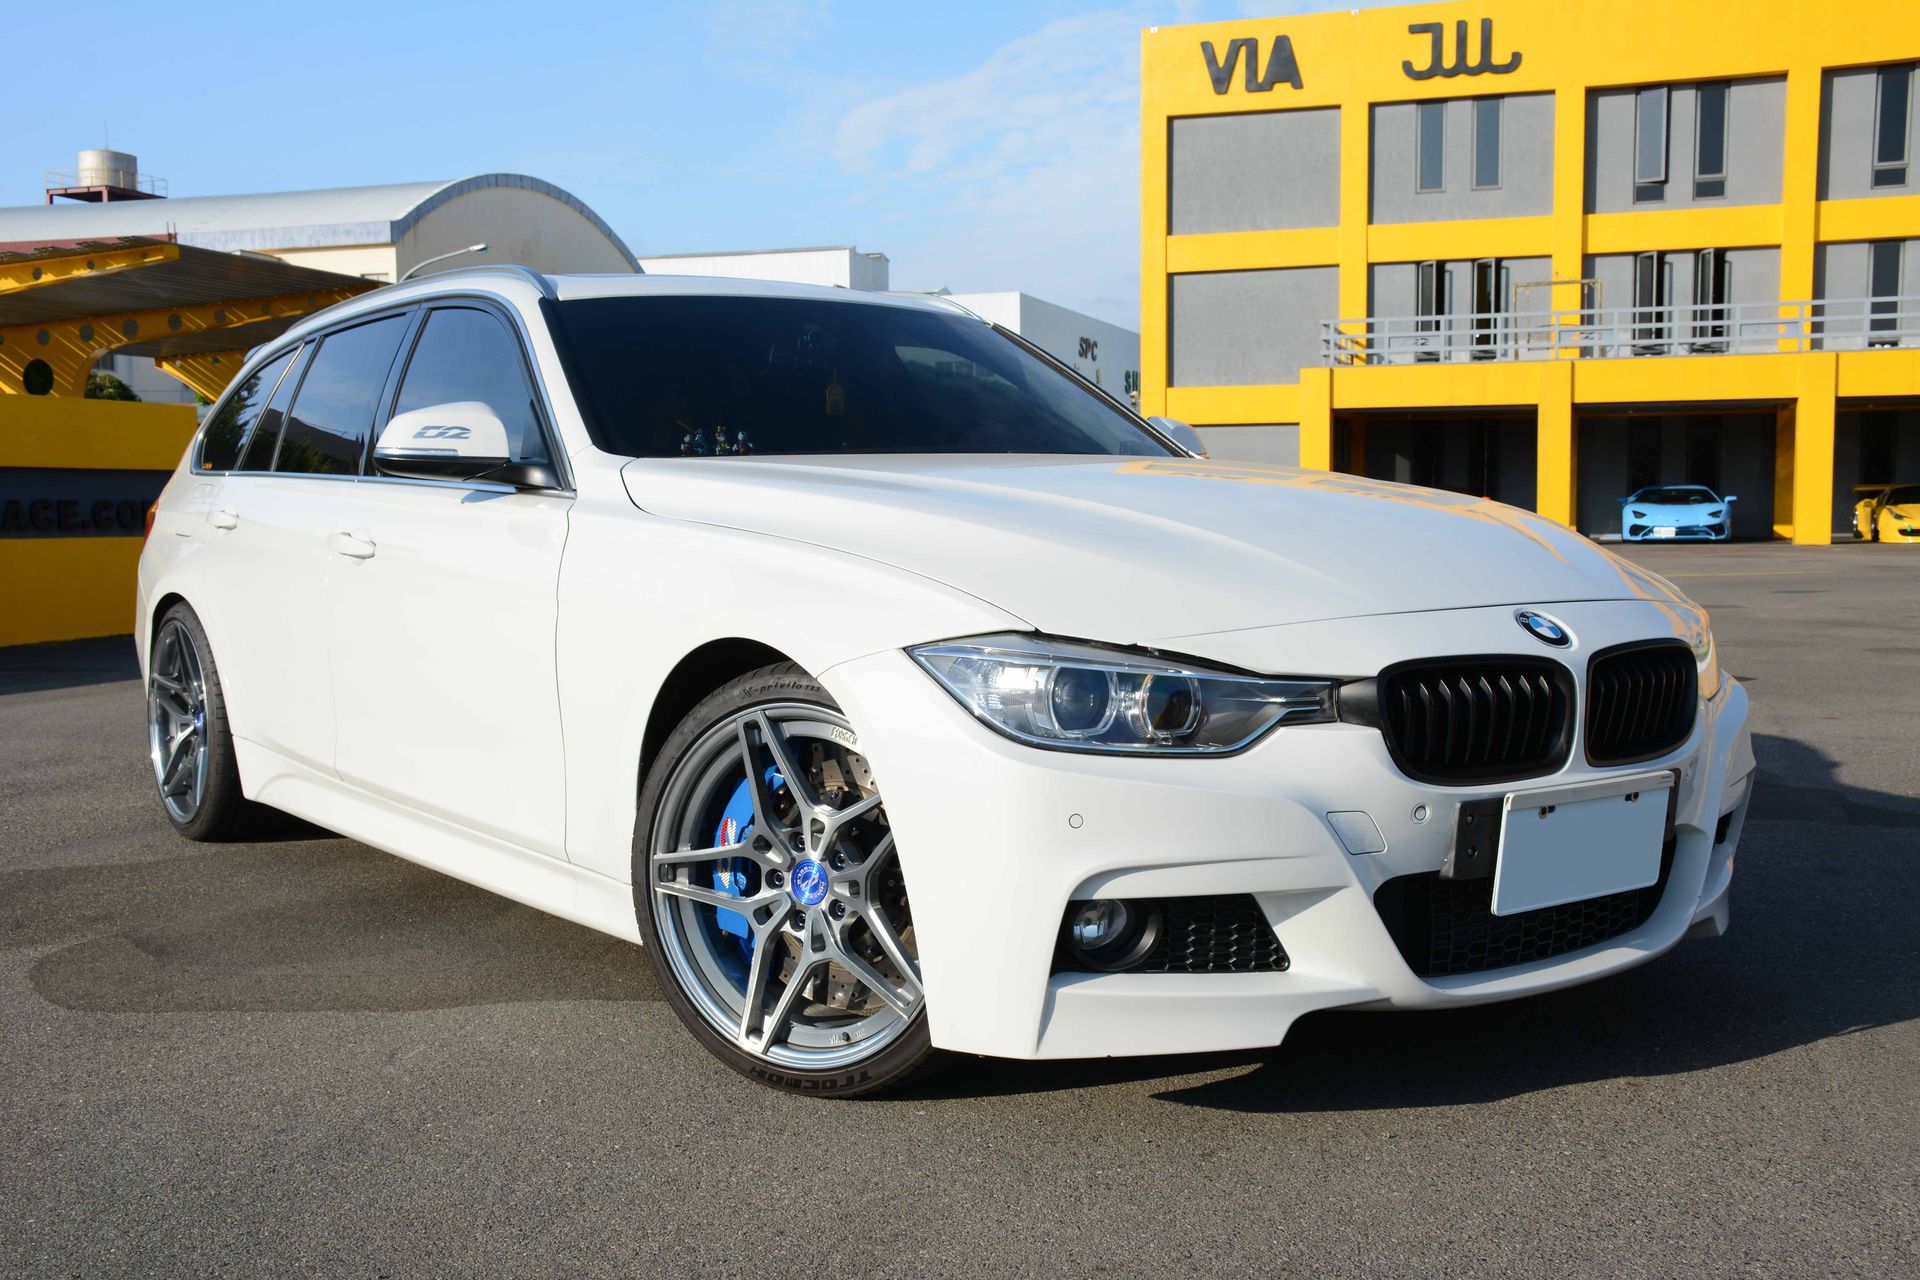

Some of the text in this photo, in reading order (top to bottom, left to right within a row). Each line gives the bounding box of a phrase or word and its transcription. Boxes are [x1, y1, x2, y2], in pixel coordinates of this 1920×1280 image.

[1200, 35, 1304, 95] VIA
[1078, 336, 1098, 362] SPC
[411, 425, 472, 440] D2
[0, 499, 147, 531] ACE.CO
